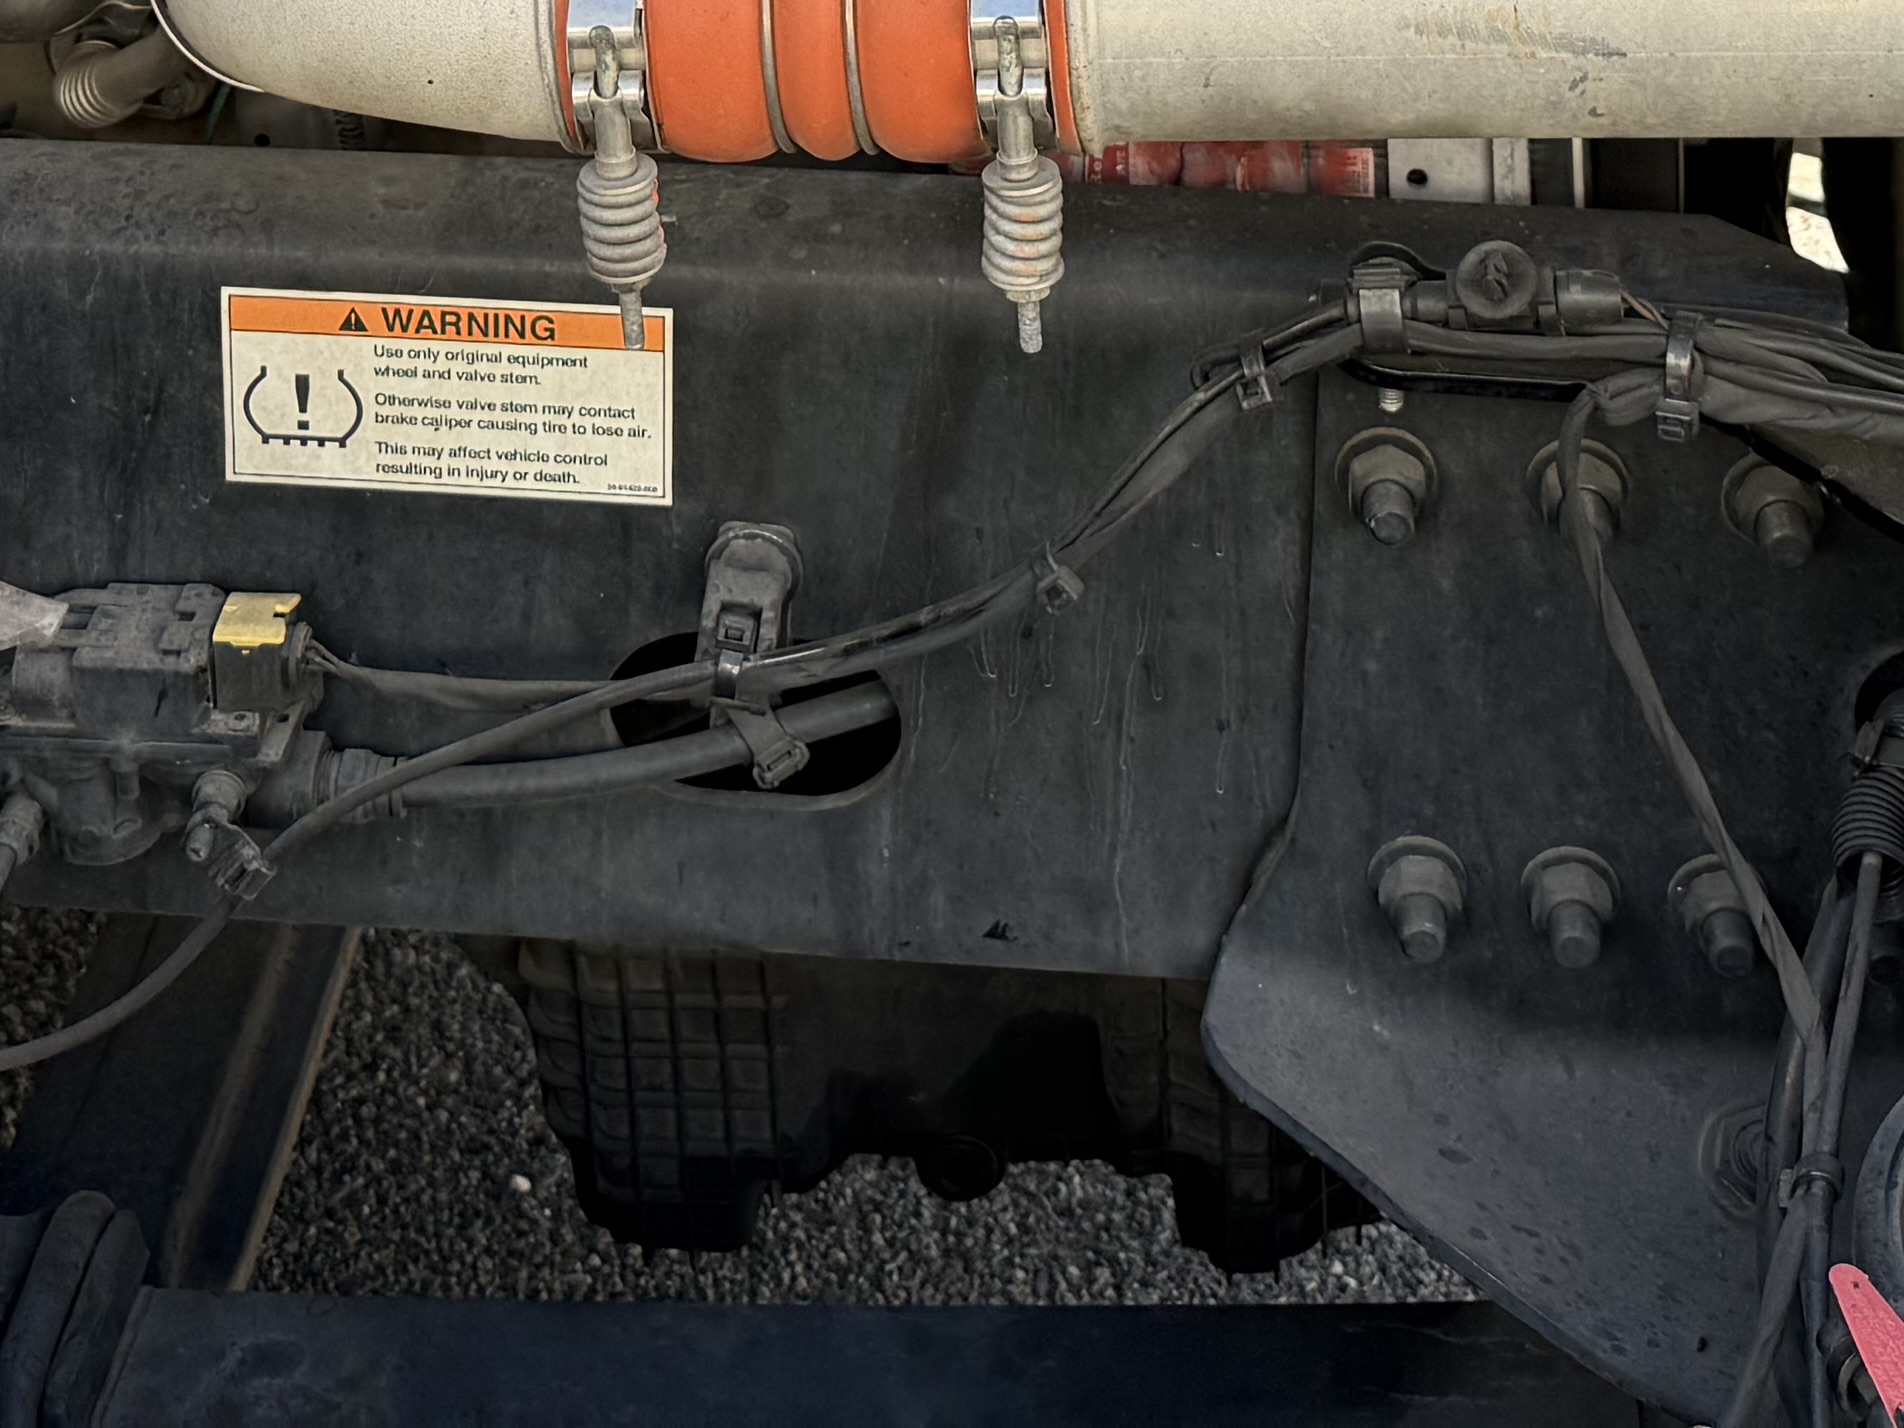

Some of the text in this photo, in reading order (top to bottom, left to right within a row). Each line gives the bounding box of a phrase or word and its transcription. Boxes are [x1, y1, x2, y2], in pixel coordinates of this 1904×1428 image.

[381, 307, 556, 341] WARNING
[374, 345, 588, 369] Use only original equipment
[374, 366, 541, 385] wheel and valve stem.
[375, 393, 635, 419] Otherwise valve stem may contact
[375, 412, 651, 438] brake caliper causing tire to lose air.
[375, 441, 608, 466] This may affect vehicle control
[376, 462, 580, 484] resulting in injury or death.
